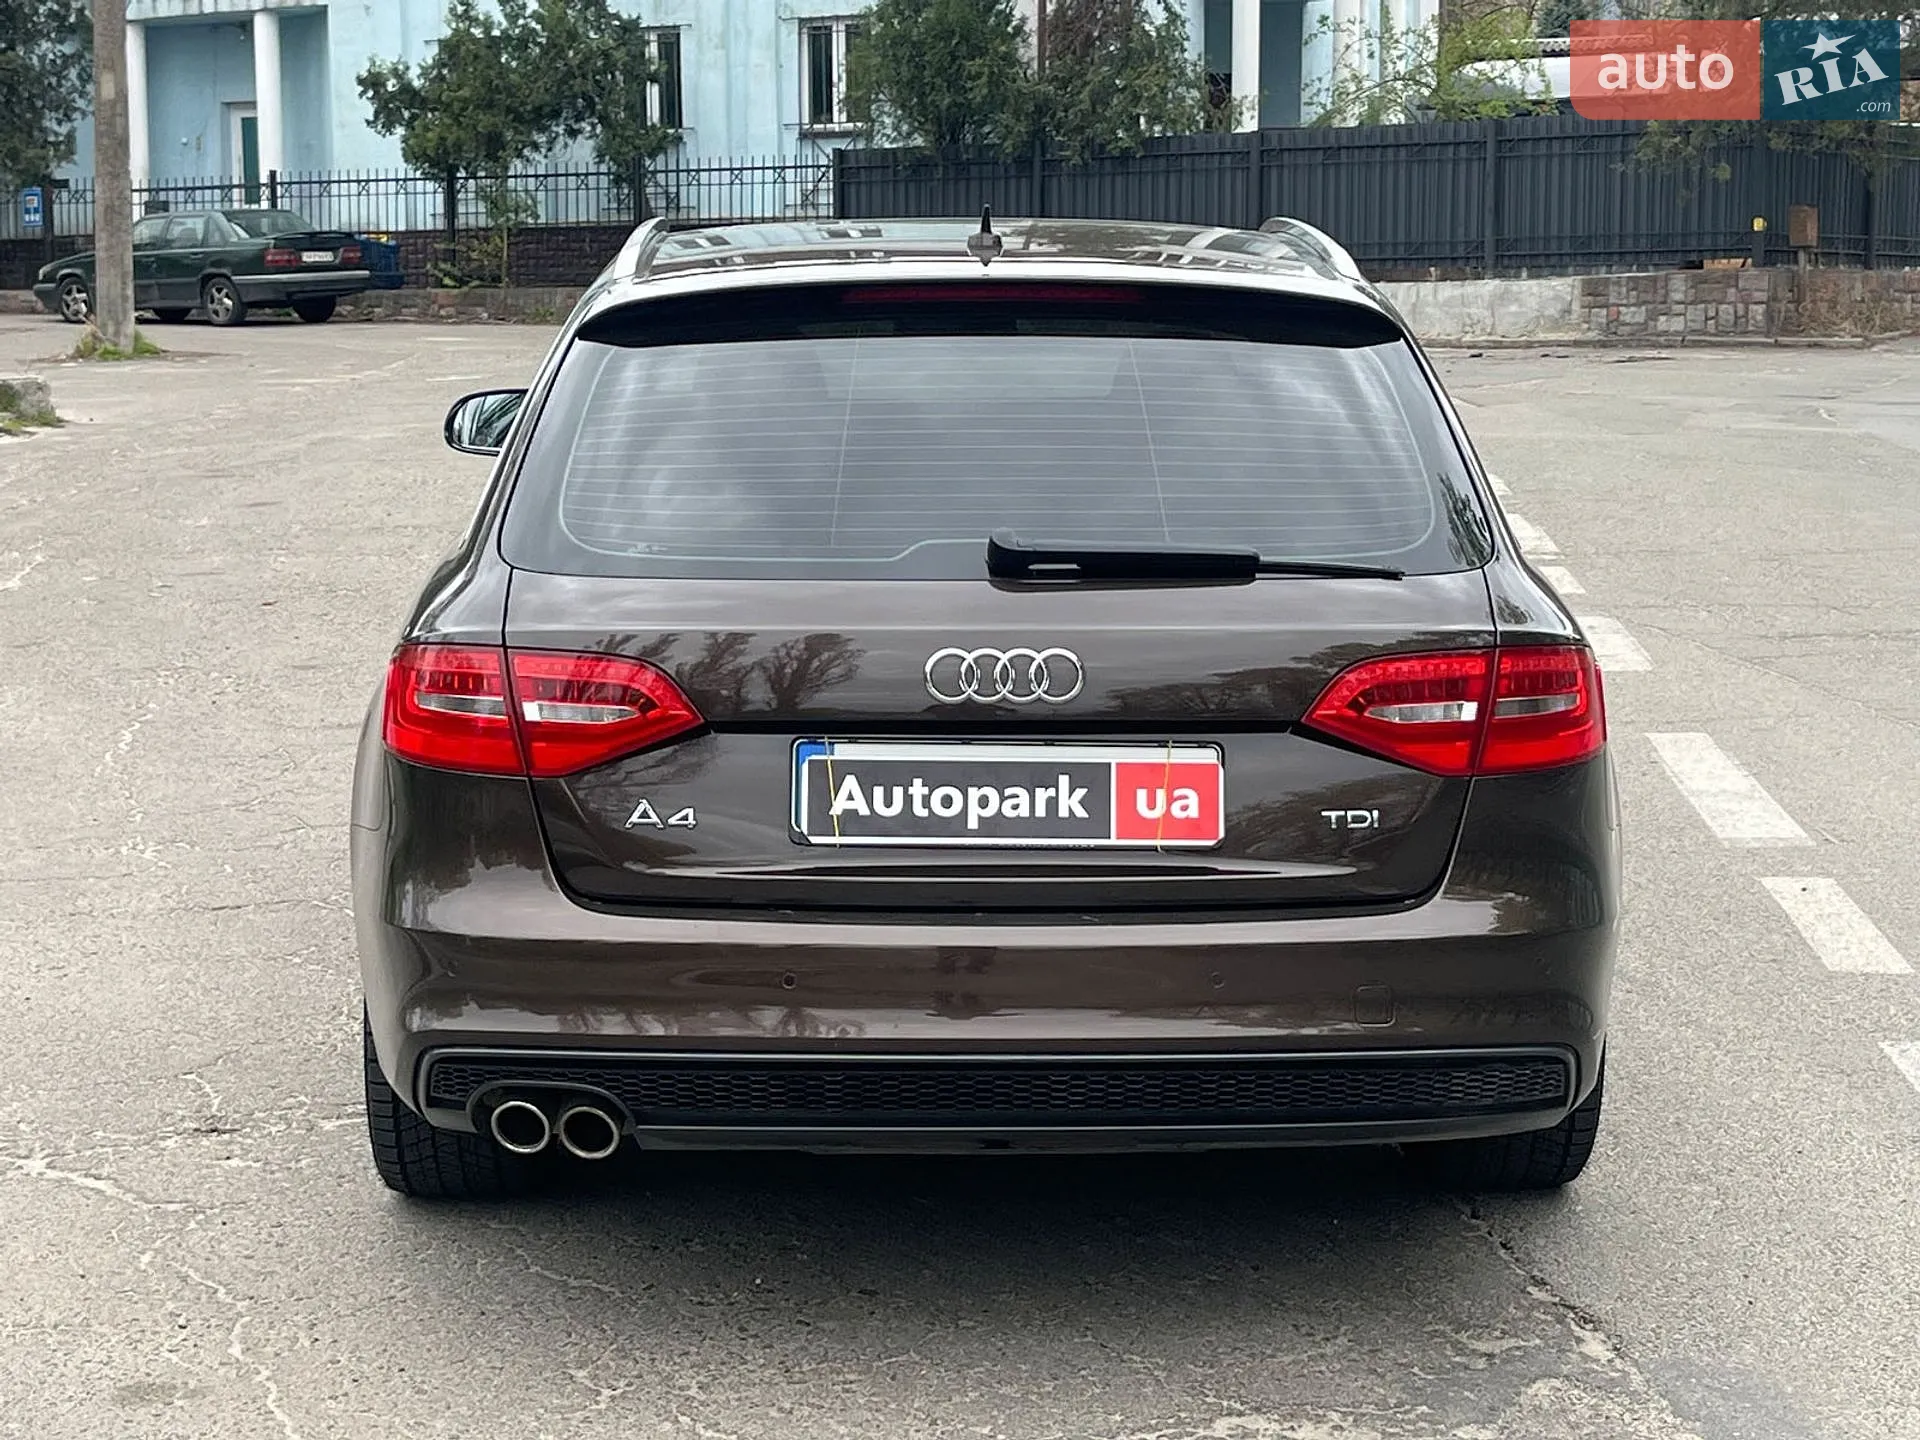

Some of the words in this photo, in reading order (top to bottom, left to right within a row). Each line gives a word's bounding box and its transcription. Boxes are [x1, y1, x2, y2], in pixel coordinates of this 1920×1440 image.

[624, 799, 697, 838] A4
[829, 774, 1089, 829] Autopark
[1136, 787, 1200, 818] ua
[1321, 810, 1379, 829] TDI
